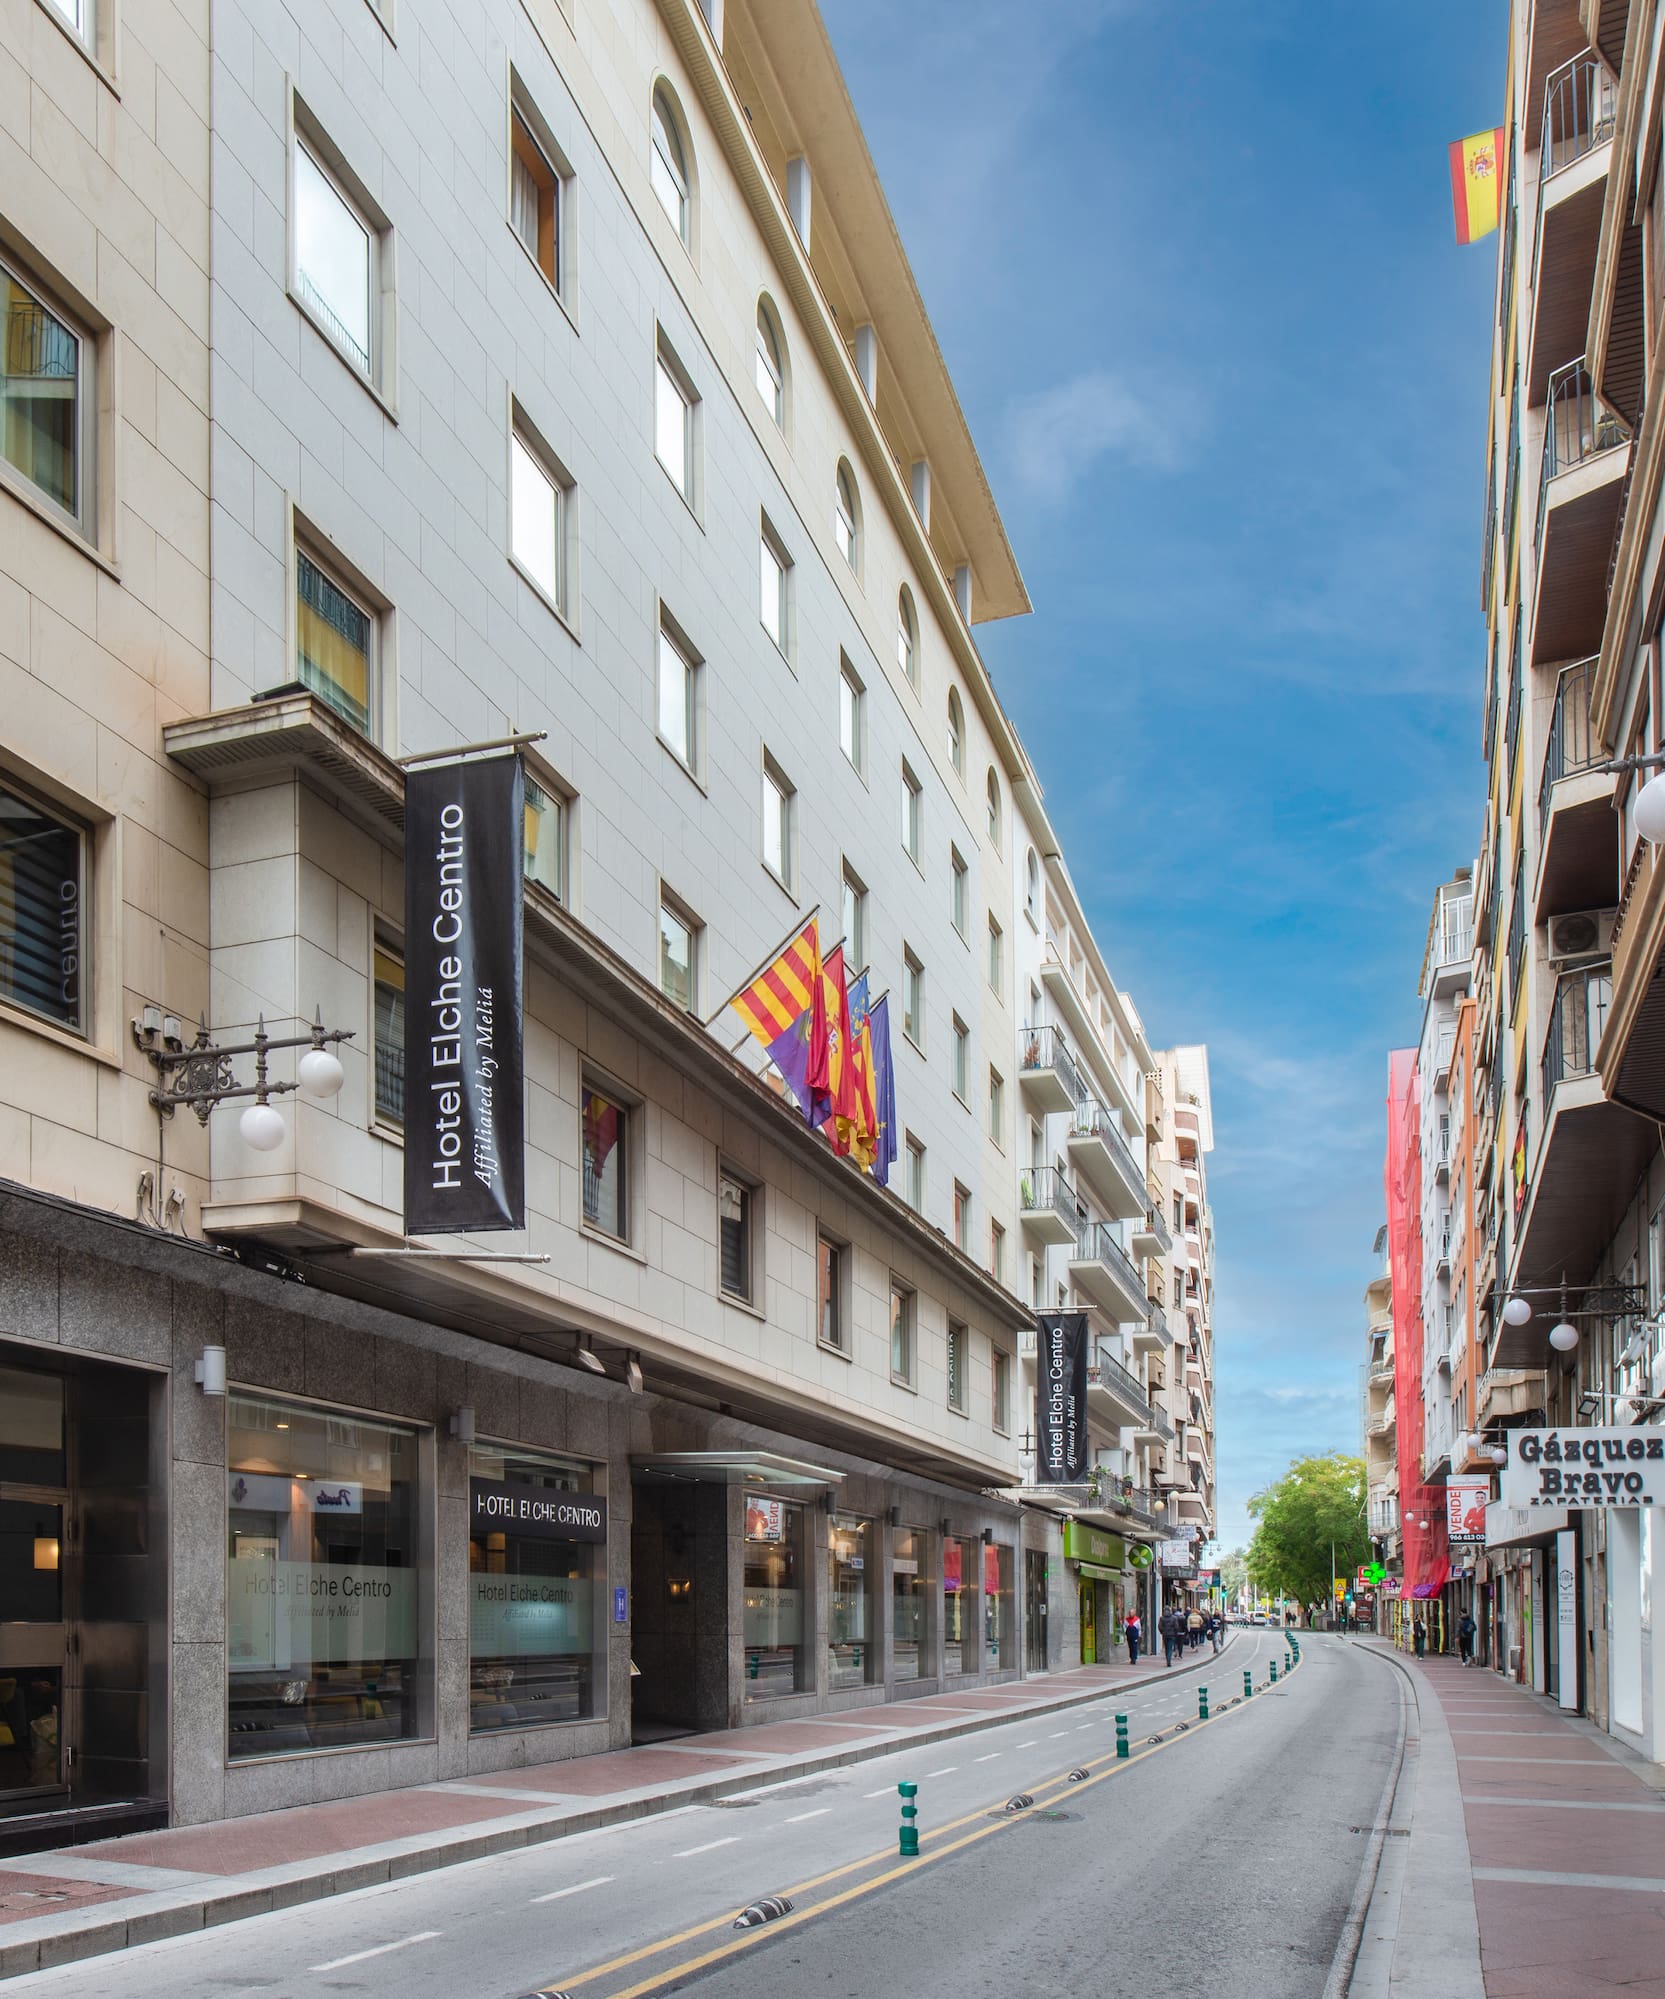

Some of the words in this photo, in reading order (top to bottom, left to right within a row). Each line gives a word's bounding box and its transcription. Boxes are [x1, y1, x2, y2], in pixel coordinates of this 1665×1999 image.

[433, 803, 464, 943] Centro
[431, 956, 462, 1067] Elche
[475, 986, 493, 1050] Meliá
[475, 1054, 499, 1079] by
[431, 1081, 462, 1189] Hotel
[473, 1083, 499, 1189] Affiliated
[1050, 1327, 1063, 1379] Centro
[1049, 1382, 1063, 1424] Elche
[1049, 1428, 1063, 1468] Hotel
[1518, 1431, 1664, 1468] Gázquez
[1530, 1496, 1653, 1505] ZAPATERIAS
[1538, 1467, 1643, 1494] Bravo
[477, 1494, 517, 1518] HOTEL
[520, 1500, 556, 1522] ELCHE
[558, 1505, 601, 1528] CENTRO
[1450, 1491, 1462, 1533] VENDE
[245, 1572, 290, 1595] Hotel
[295, 1573, 338, 1596] Elche
[342, 1576, 392, 1598] Centro
[478, 1583, 507, 1601] Hotel
[510, 1583, 538, 1602] Elche
[541, 1585, 574, 1603] Centro
[617, 1597, 624, 1612] H
